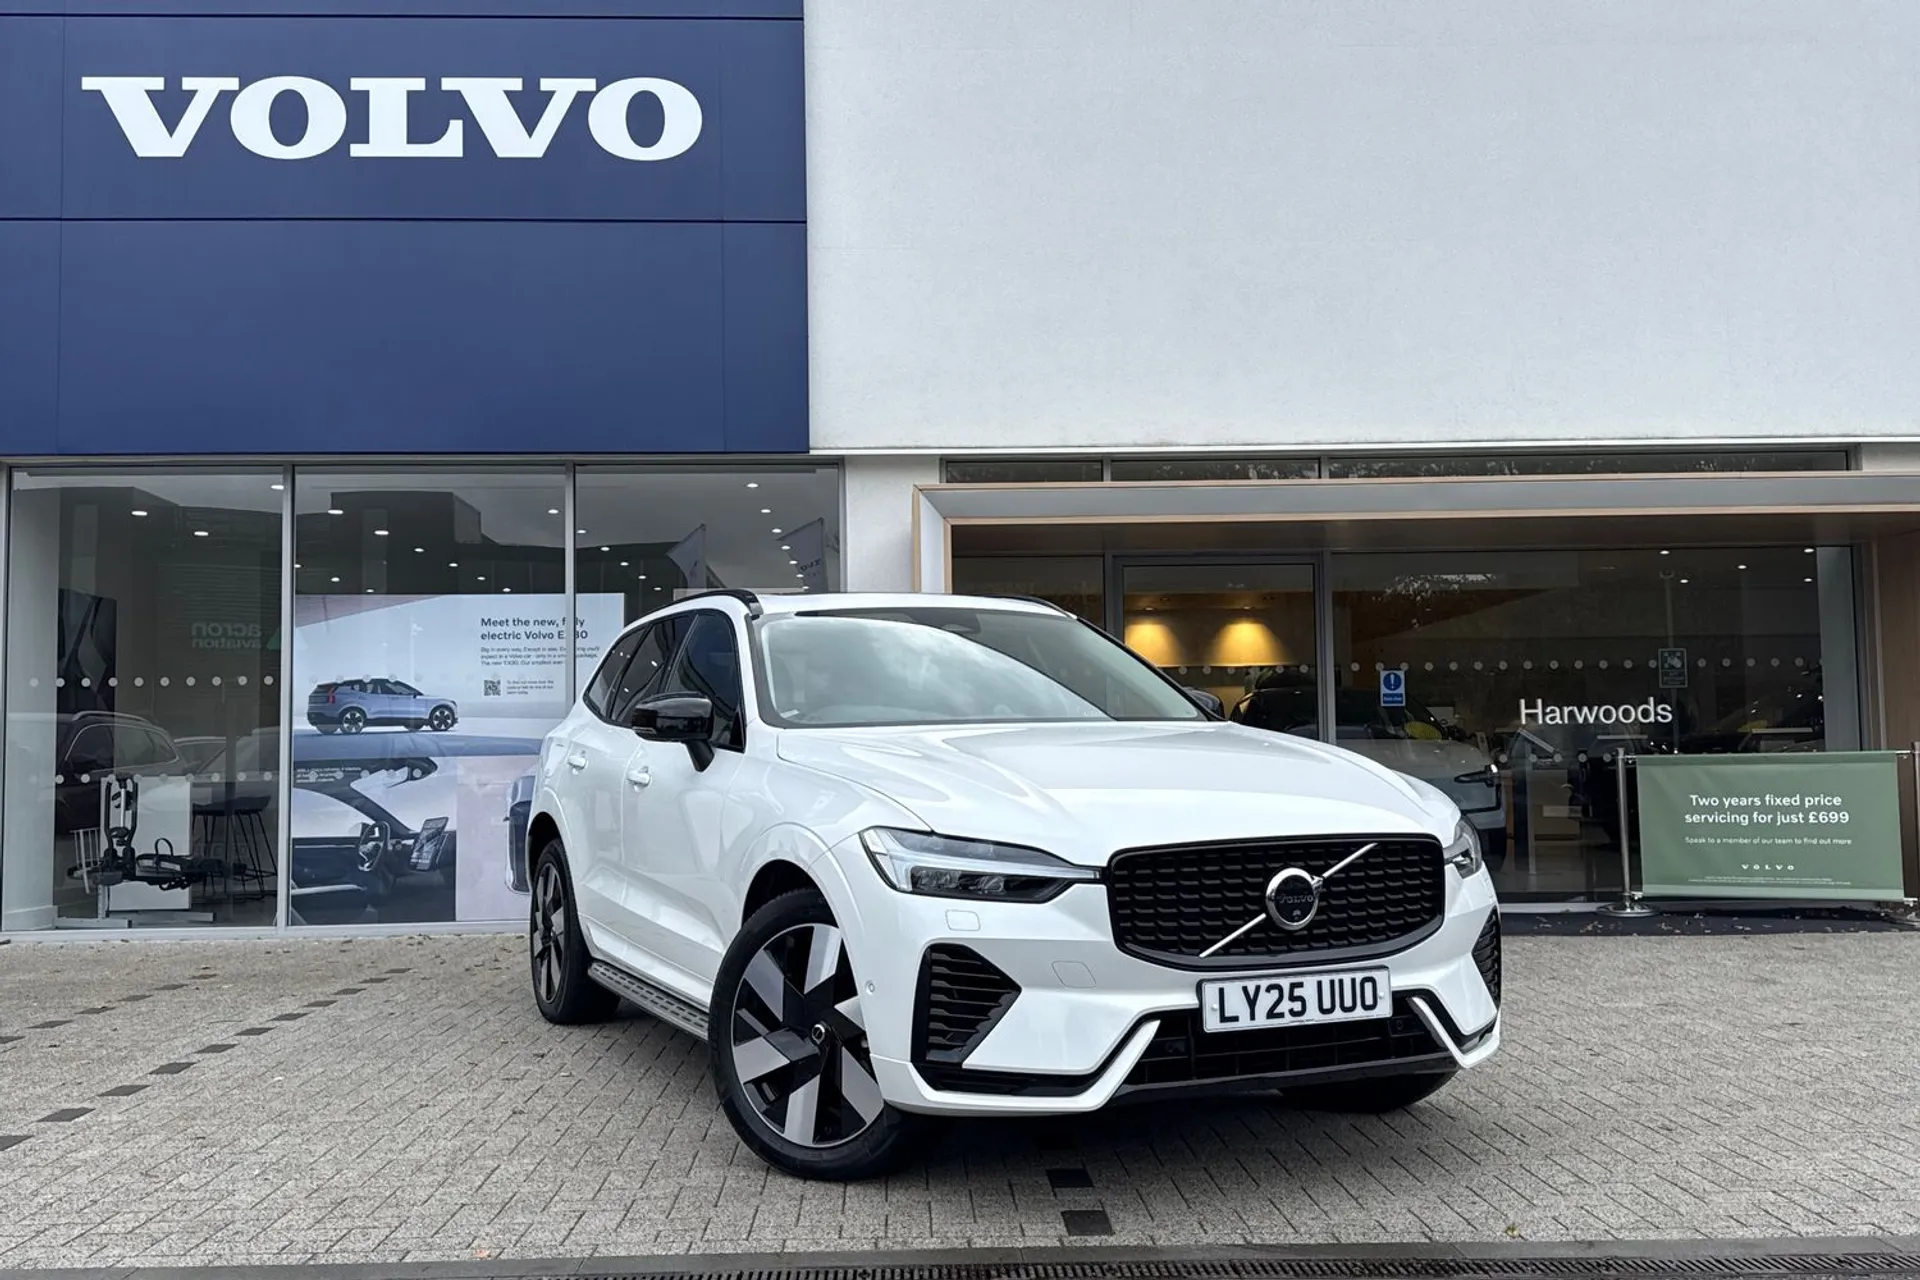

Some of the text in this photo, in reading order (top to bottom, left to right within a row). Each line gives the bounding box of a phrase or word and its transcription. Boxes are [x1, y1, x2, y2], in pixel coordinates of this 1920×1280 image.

[81, 75, 702, 161] VOLVO
[481, 617, 509, 627] Meet
[512, 617, 530, 627] the
[533, 618, 559, 628] new,
[481, 629, 589, 640] electric Volvo E30
[1519, 696, 1673, 725] Harwoods
[1689, 794, 1842, 809] Two years fixed price
[1684, 811, 1850, 826] servicing for just £699
[1685, 837, 1706, 845] Speak
[1722, 837, 1751, 845] member
[1794, 837, 1802, 845] to
[1803, 837, 1817, 845] find
[1218, 981, 1307, 1023] LY25
